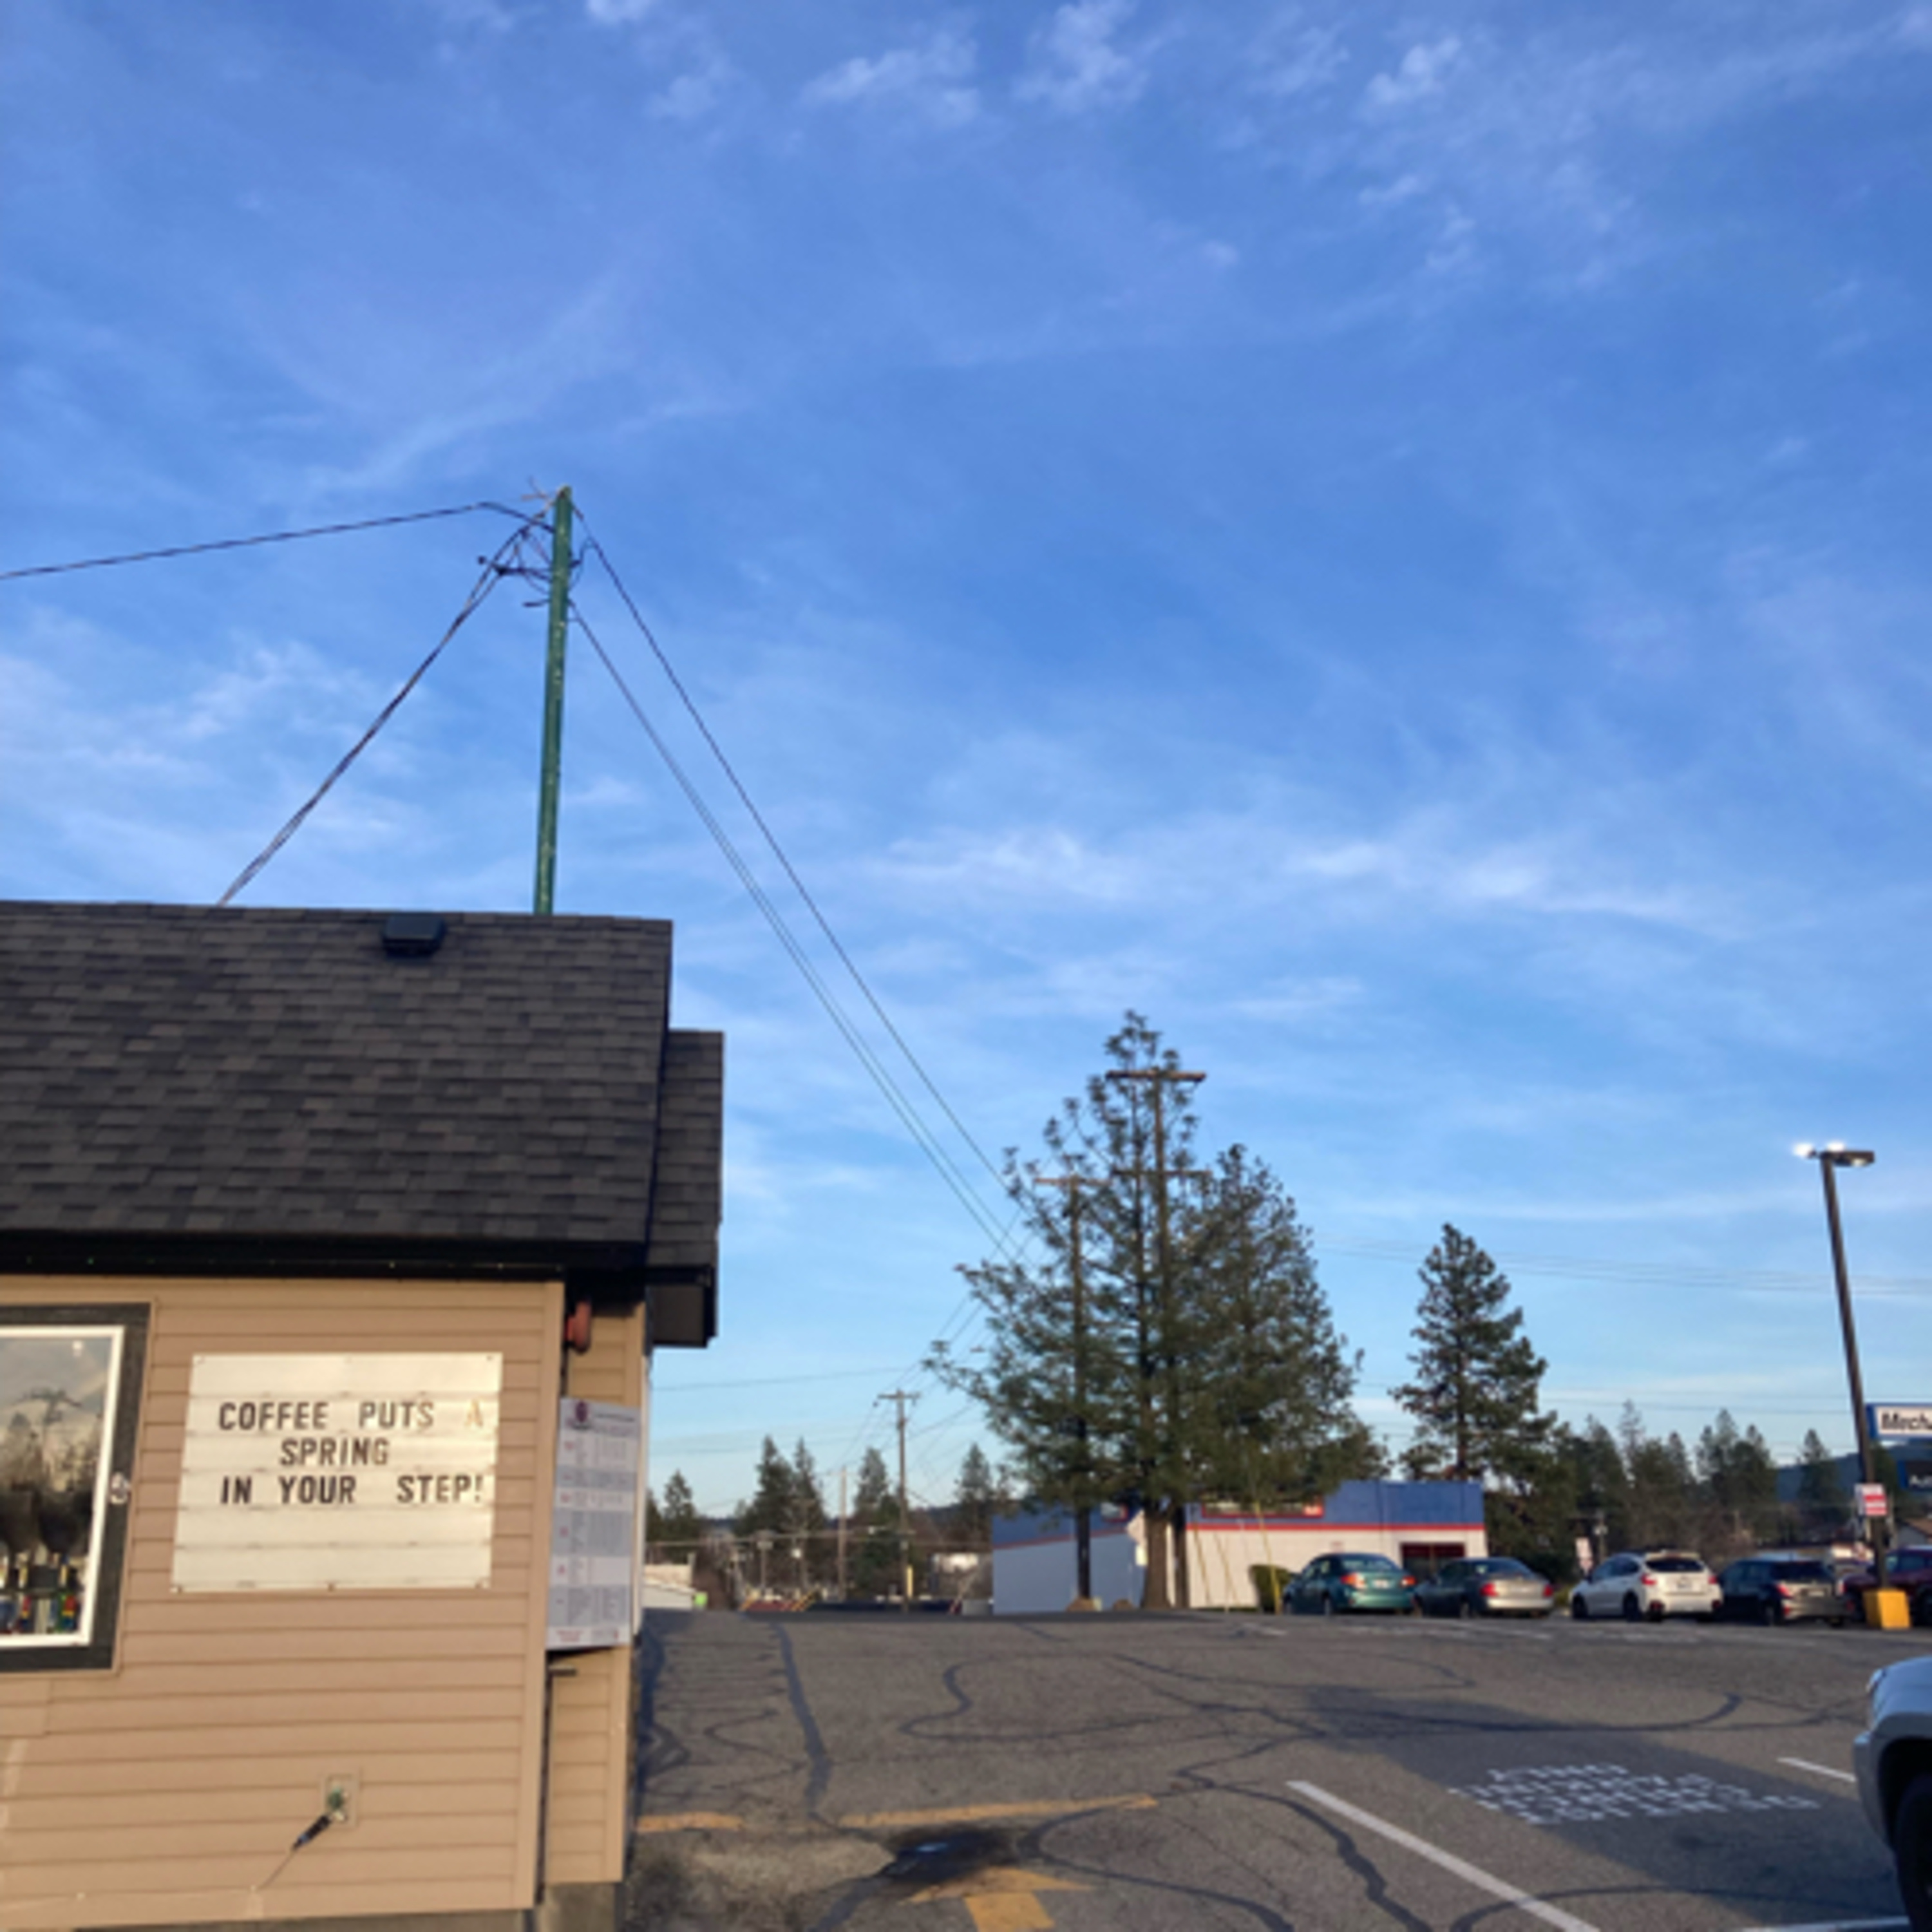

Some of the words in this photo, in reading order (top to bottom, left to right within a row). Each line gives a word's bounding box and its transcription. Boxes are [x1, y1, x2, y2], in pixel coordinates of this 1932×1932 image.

[219, 1401, 328, 1431] COFFEE
[359, 1401, 434, 1429] PUTS
[464, 1400, 484, 1428] A
[279, 1437, 390, 1466] SPRING
[220, 1475, 252, 1505] IN
[278, 1475, 357, 1505] YOUR
[397, 1474, 483, 1504] STEP!
